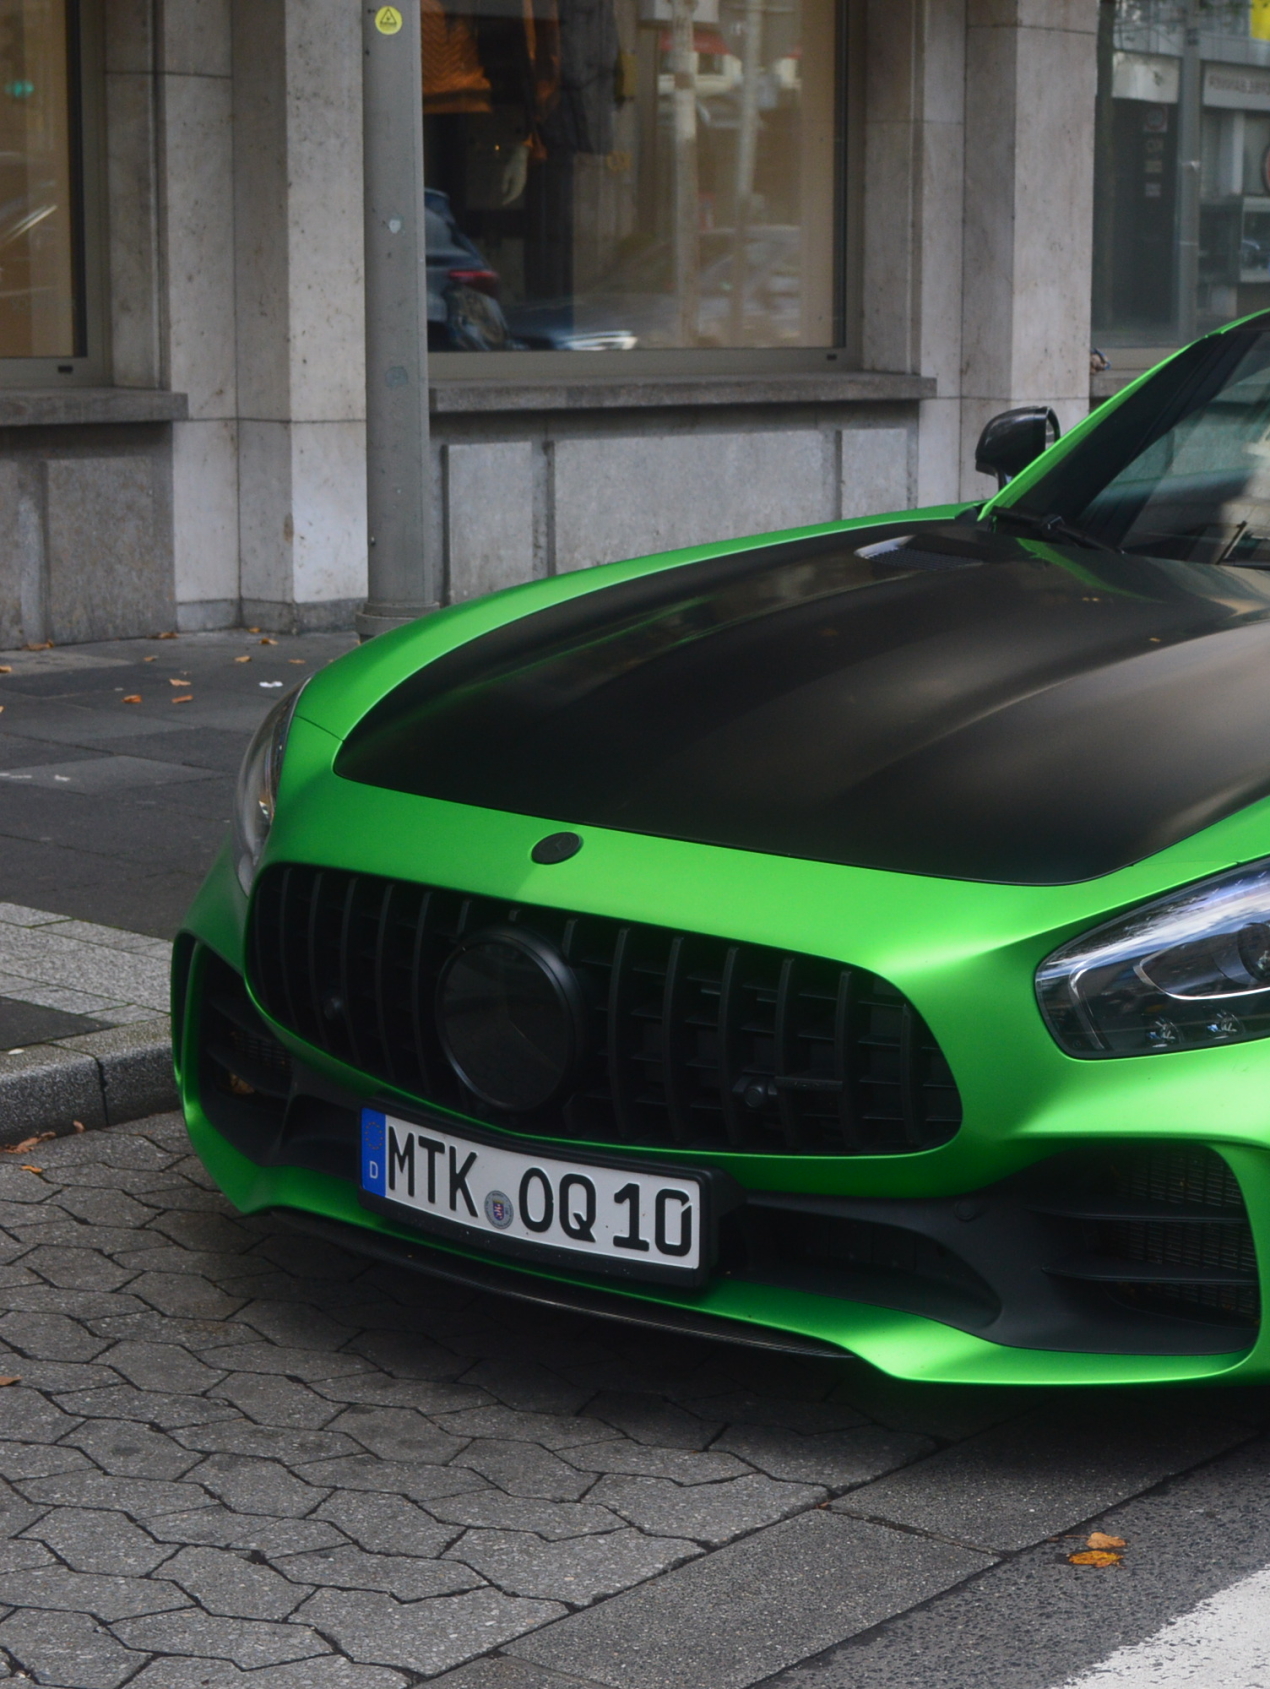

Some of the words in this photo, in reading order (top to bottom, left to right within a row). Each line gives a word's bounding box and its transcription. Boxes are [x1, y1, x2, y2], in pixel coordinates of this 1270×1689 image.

[369, 1160, 379, 1179] D
[388, 1125, 479, 1218] MTK
[518, 1167, 597, 1243] OQ
[612, 1182, 693, 1257] 10
